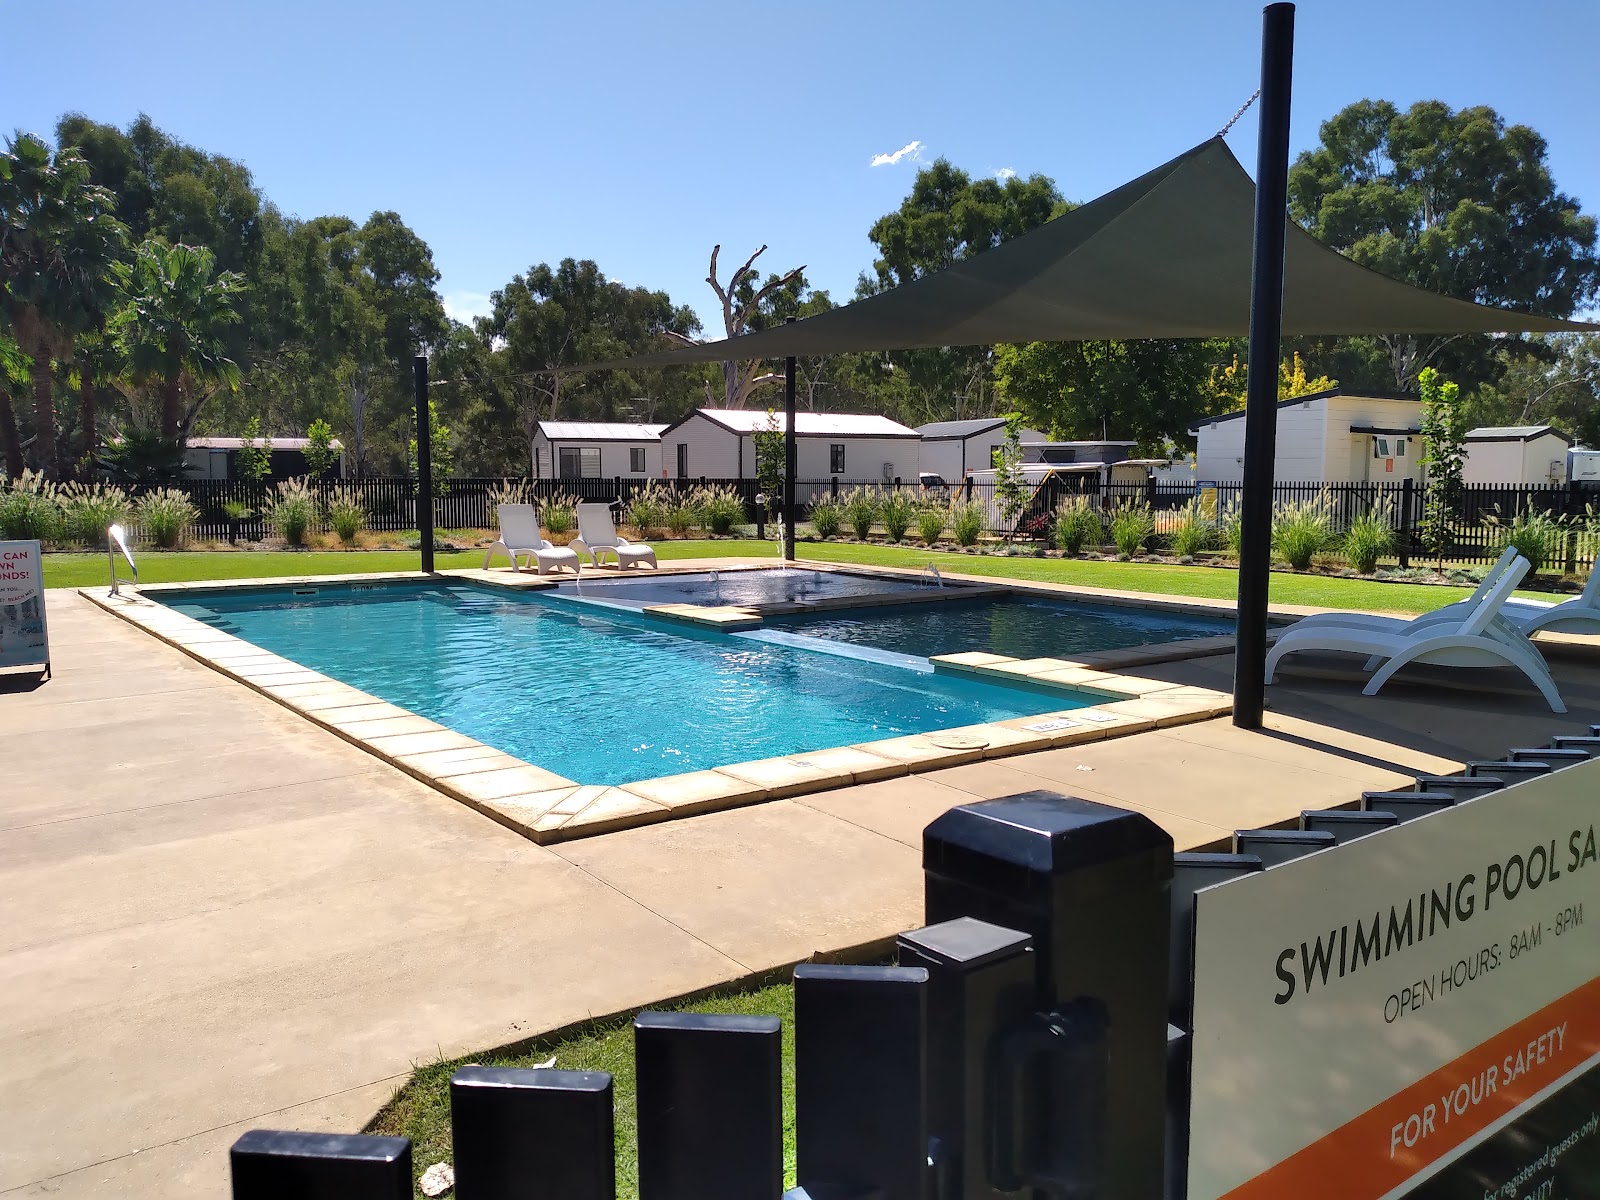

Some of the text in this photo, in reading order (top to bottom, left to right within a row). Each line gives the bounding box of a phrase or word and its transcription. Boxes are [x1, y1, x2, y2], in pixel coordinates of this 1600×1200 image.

[0, 571, 29, 580] NDS!
[3, 552, 28, 560] CAN
[1274, 823, 1600, 1005] SWIMMING POOL SA
[1384, 975, 1435, 1024] OPEN
[1440, 943, 1502, 997] HOURS:
[1509, 922, 1542, 959] 8AM
[1555, 903, 1583, 936] 8PM
[1389, 1021, 1568, 1159] FOR YOUR SAFETY
[1500, 1145, 1549, 1198] registered
[1550, 1130, 1579, 1167] guests
[1580, 1111, 1599, 1135] only
